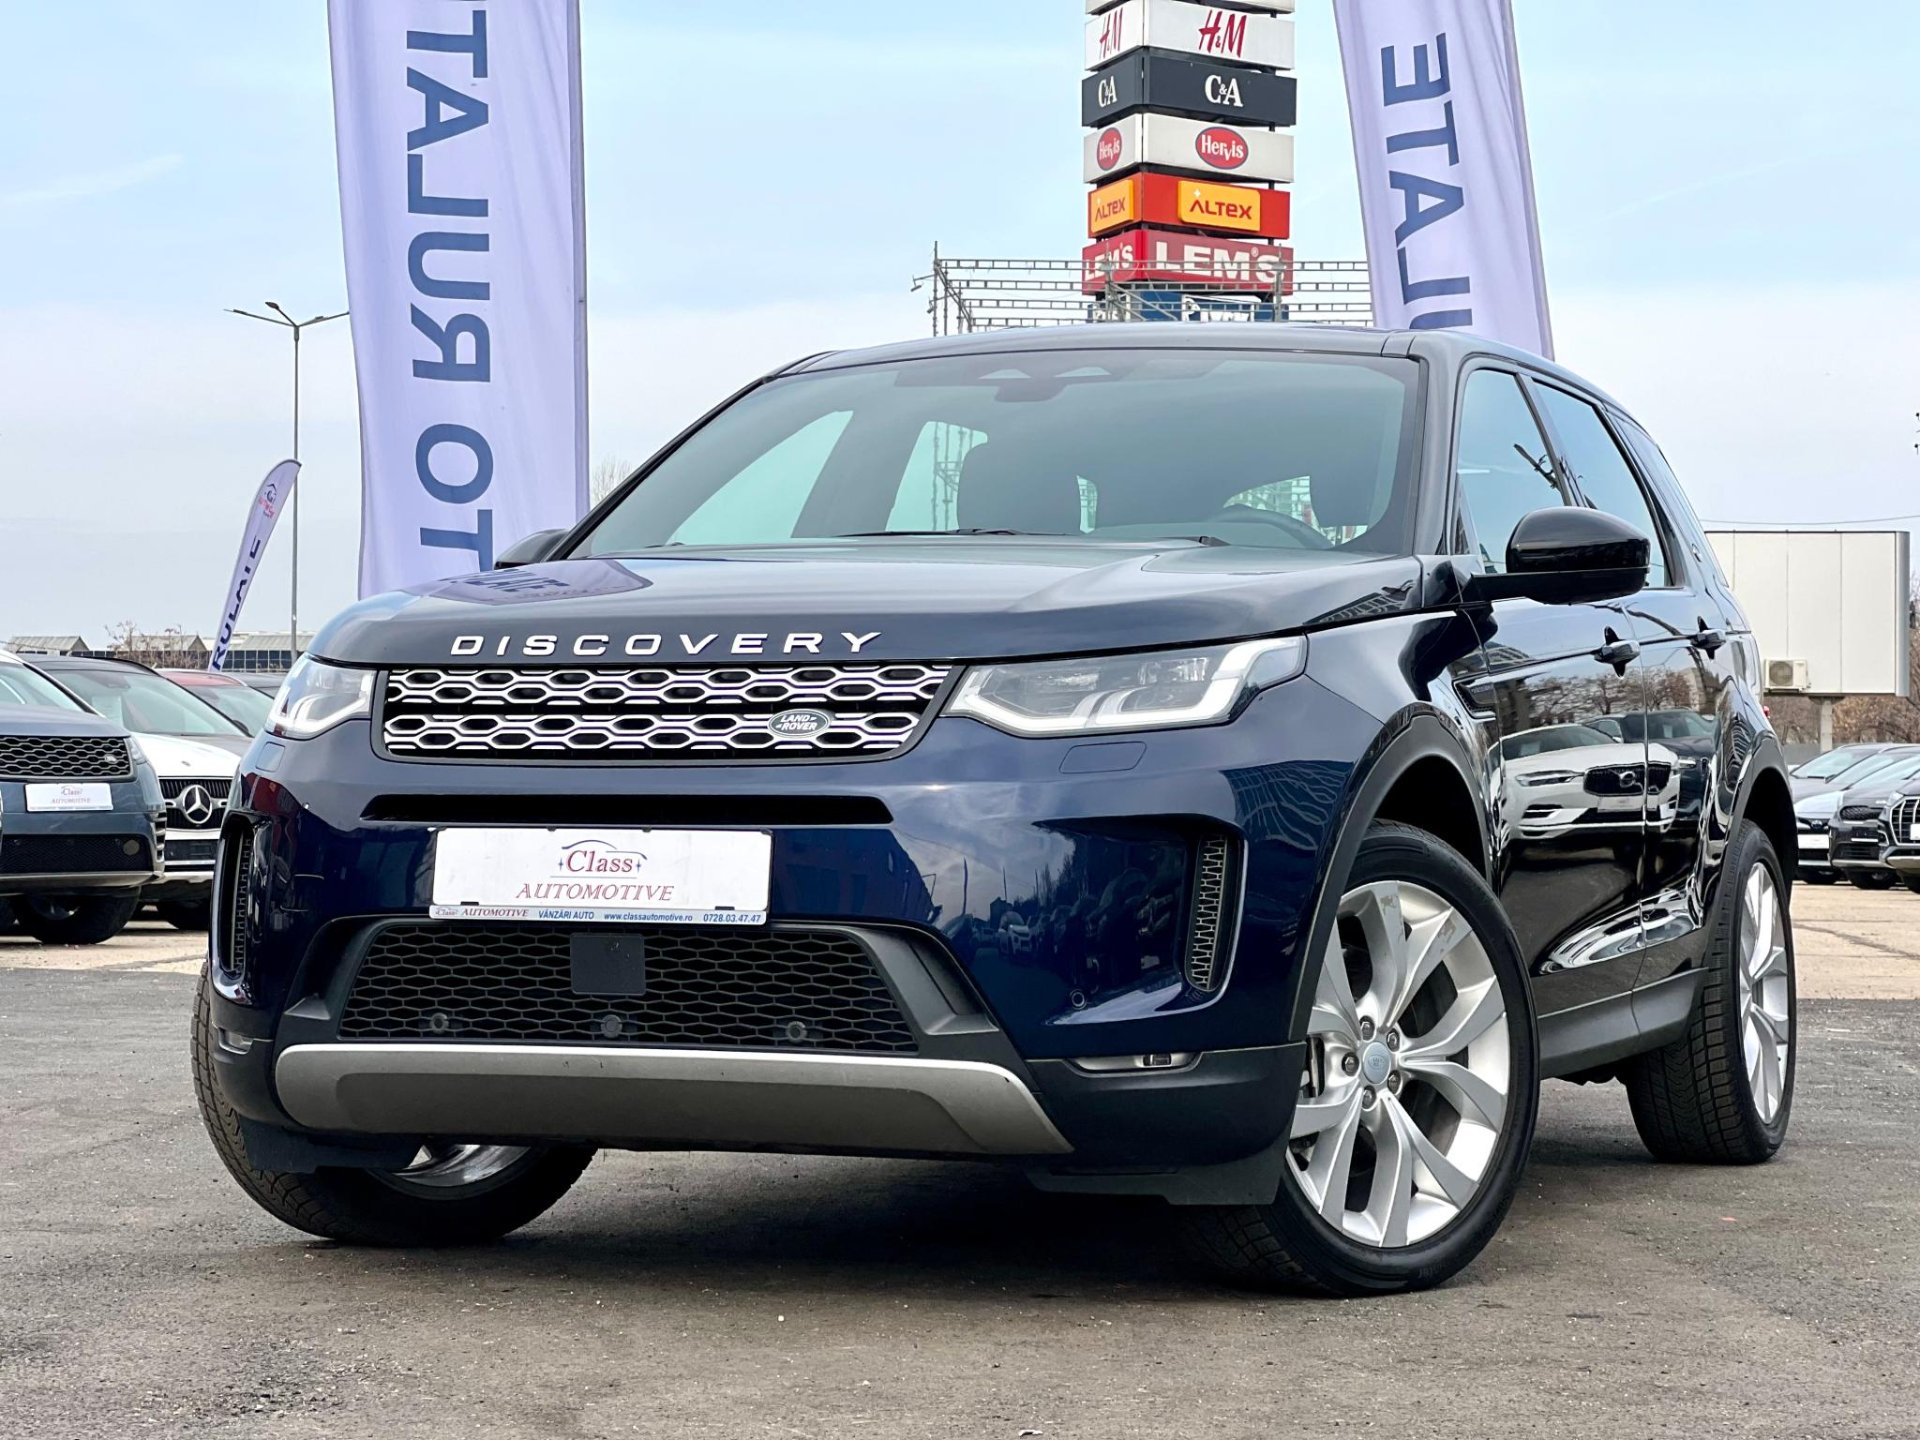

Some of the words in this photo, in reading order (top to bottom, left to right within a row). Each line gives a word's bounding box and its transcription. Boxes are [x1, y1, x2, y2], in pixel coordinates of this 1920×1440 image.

[1198, 9, 1248, 58] H&M
[1098, 75, 1118, 108] C&A
[1204, 74, 1244, 107] C&A
[1200, 134, 1245, 161] Hervis
[450, 631, 882, 656] DISCOVERY
[780, 714, 811, 722] LAND
[781, 722, 818, 731] ROVER
[567, 850, 634, 873] Class
[515, 883, 675, 901] AUTOMOTIVE
[462, 909, 529, 918] AUTOMOTIVE
[573, 911, 595, 920] AUTO
[604, 911, 693, 922] www.classautomotive.ro
[703, 914, 761, 923] 0728.03.47.47
